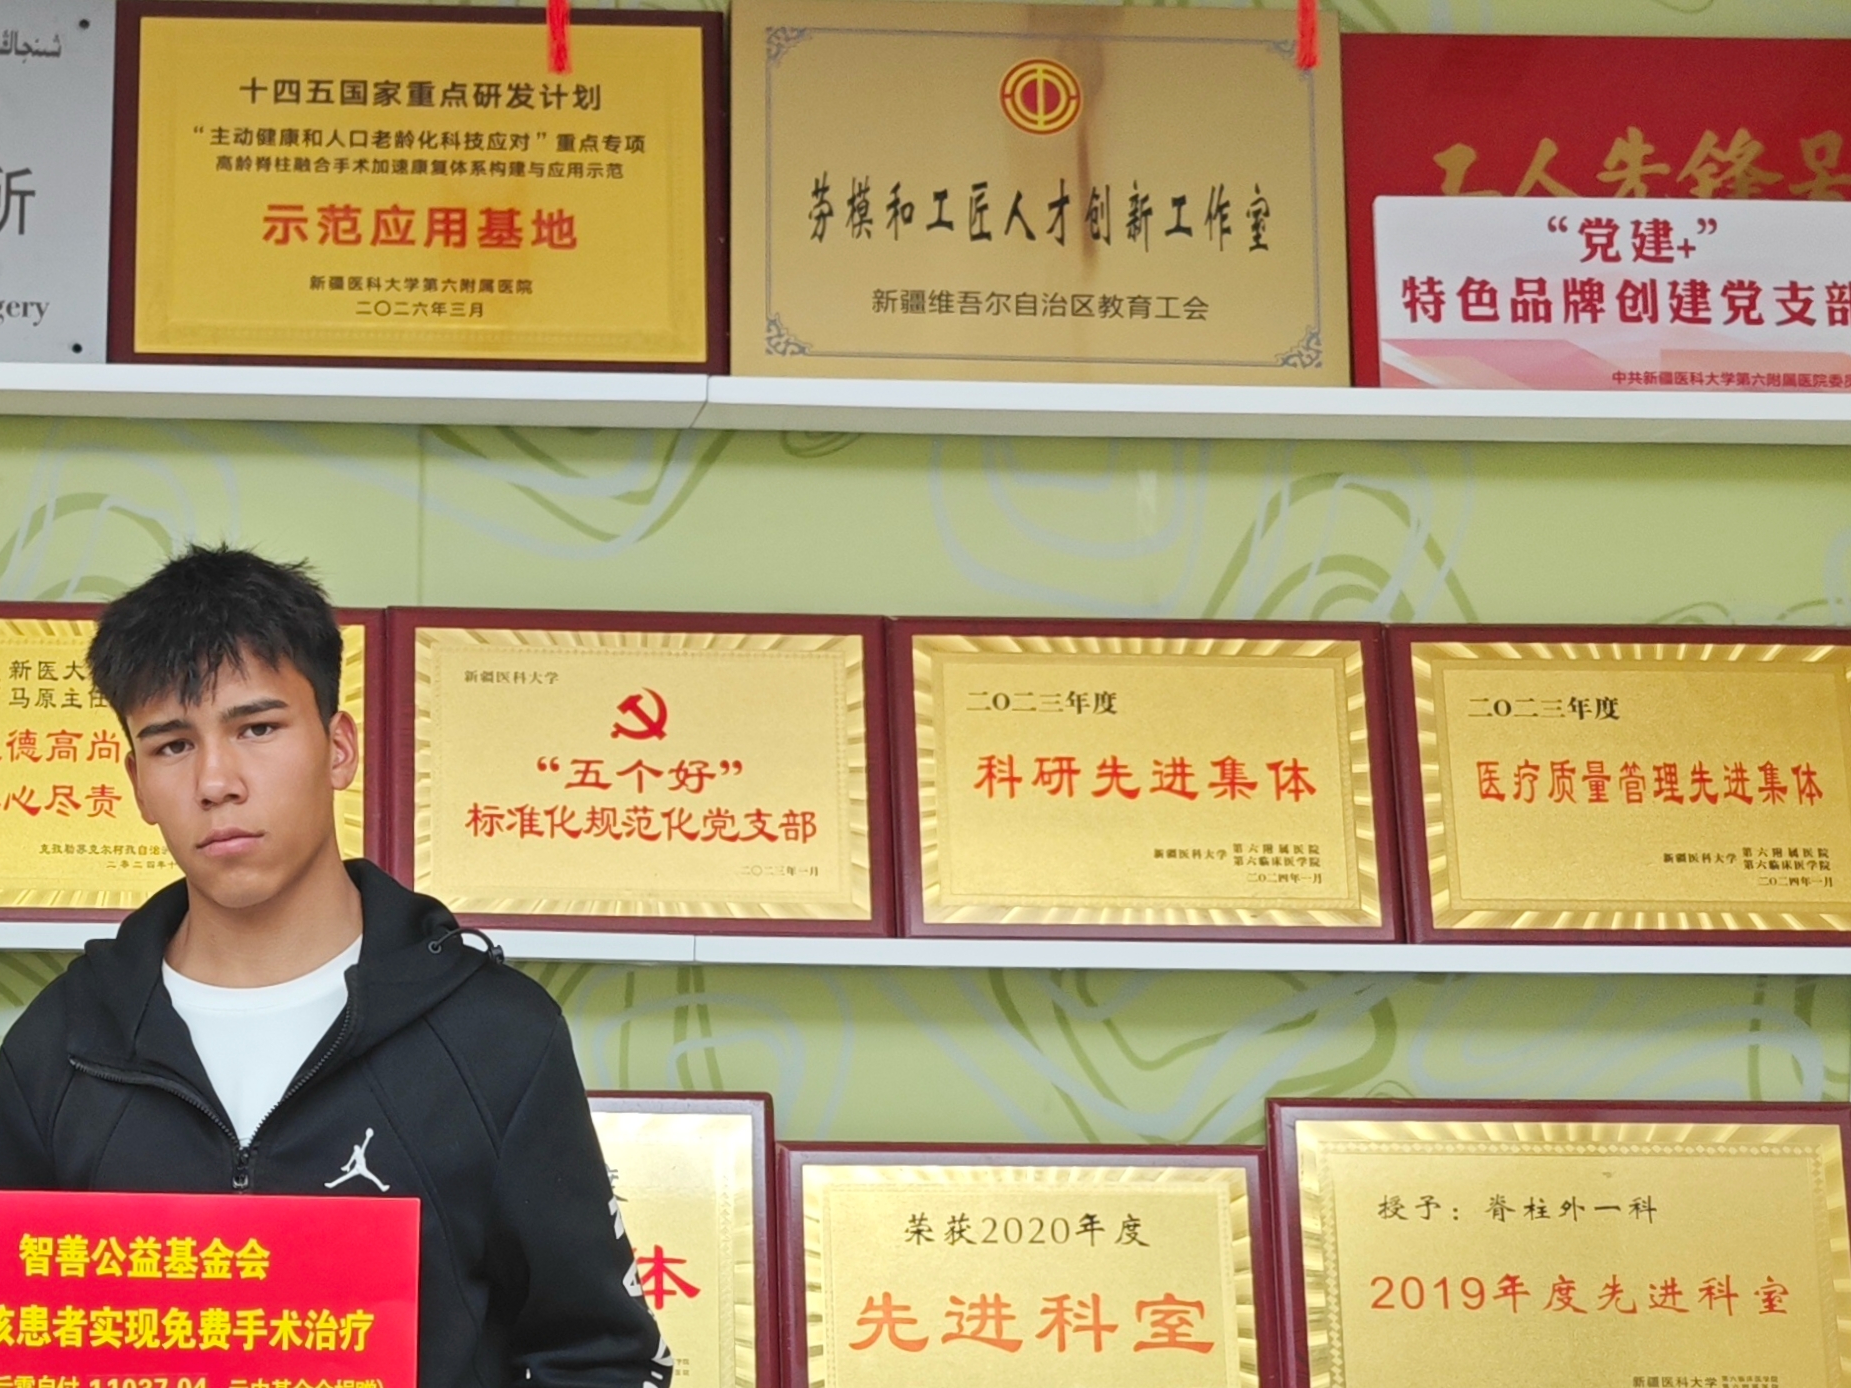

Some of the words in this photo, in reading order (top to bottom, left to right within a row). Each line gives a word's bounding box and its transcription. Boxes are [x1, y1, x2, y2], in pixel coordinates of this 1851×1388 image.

[240, 78, 602, 111] 十四五国家重点研发计划
[216, 155, 624, 180] 高龄脊柱融合手术加速康复体系构建与应用示范
[262, 204, 578, 250] 示范应用基地
[807, 172, 1272, 252] 劳模和工匠人才创新工作室
[309, 274, 533, 296] 新疆医科大学第六附属医院
[871, 288, 1210, 322] 新疆维吾尔自治区教育工会
[8, 660, 87, 682] 新医大
[464, 669, 559, 686] 新疆医科大学
[536, 756, 744, 794] “五个好”
[973, 754, 1318, 803] 科研先进集体
[1476, 759, 1824, 806] 医疗质量管理先进集体
[465, 803, 818, 845] 标准化规范化党支部
[904, 1212, 1150, 1248] 荣获2020年度
[19, 1233, 270, 1280] 智善公益基金会
[1370, 1274, 1790, 1316] 2019年度先进科室
[849, 1291, 1215, 1353] 先进科室
[1632, 1376, 1717, 1388] 新疆医科大学
